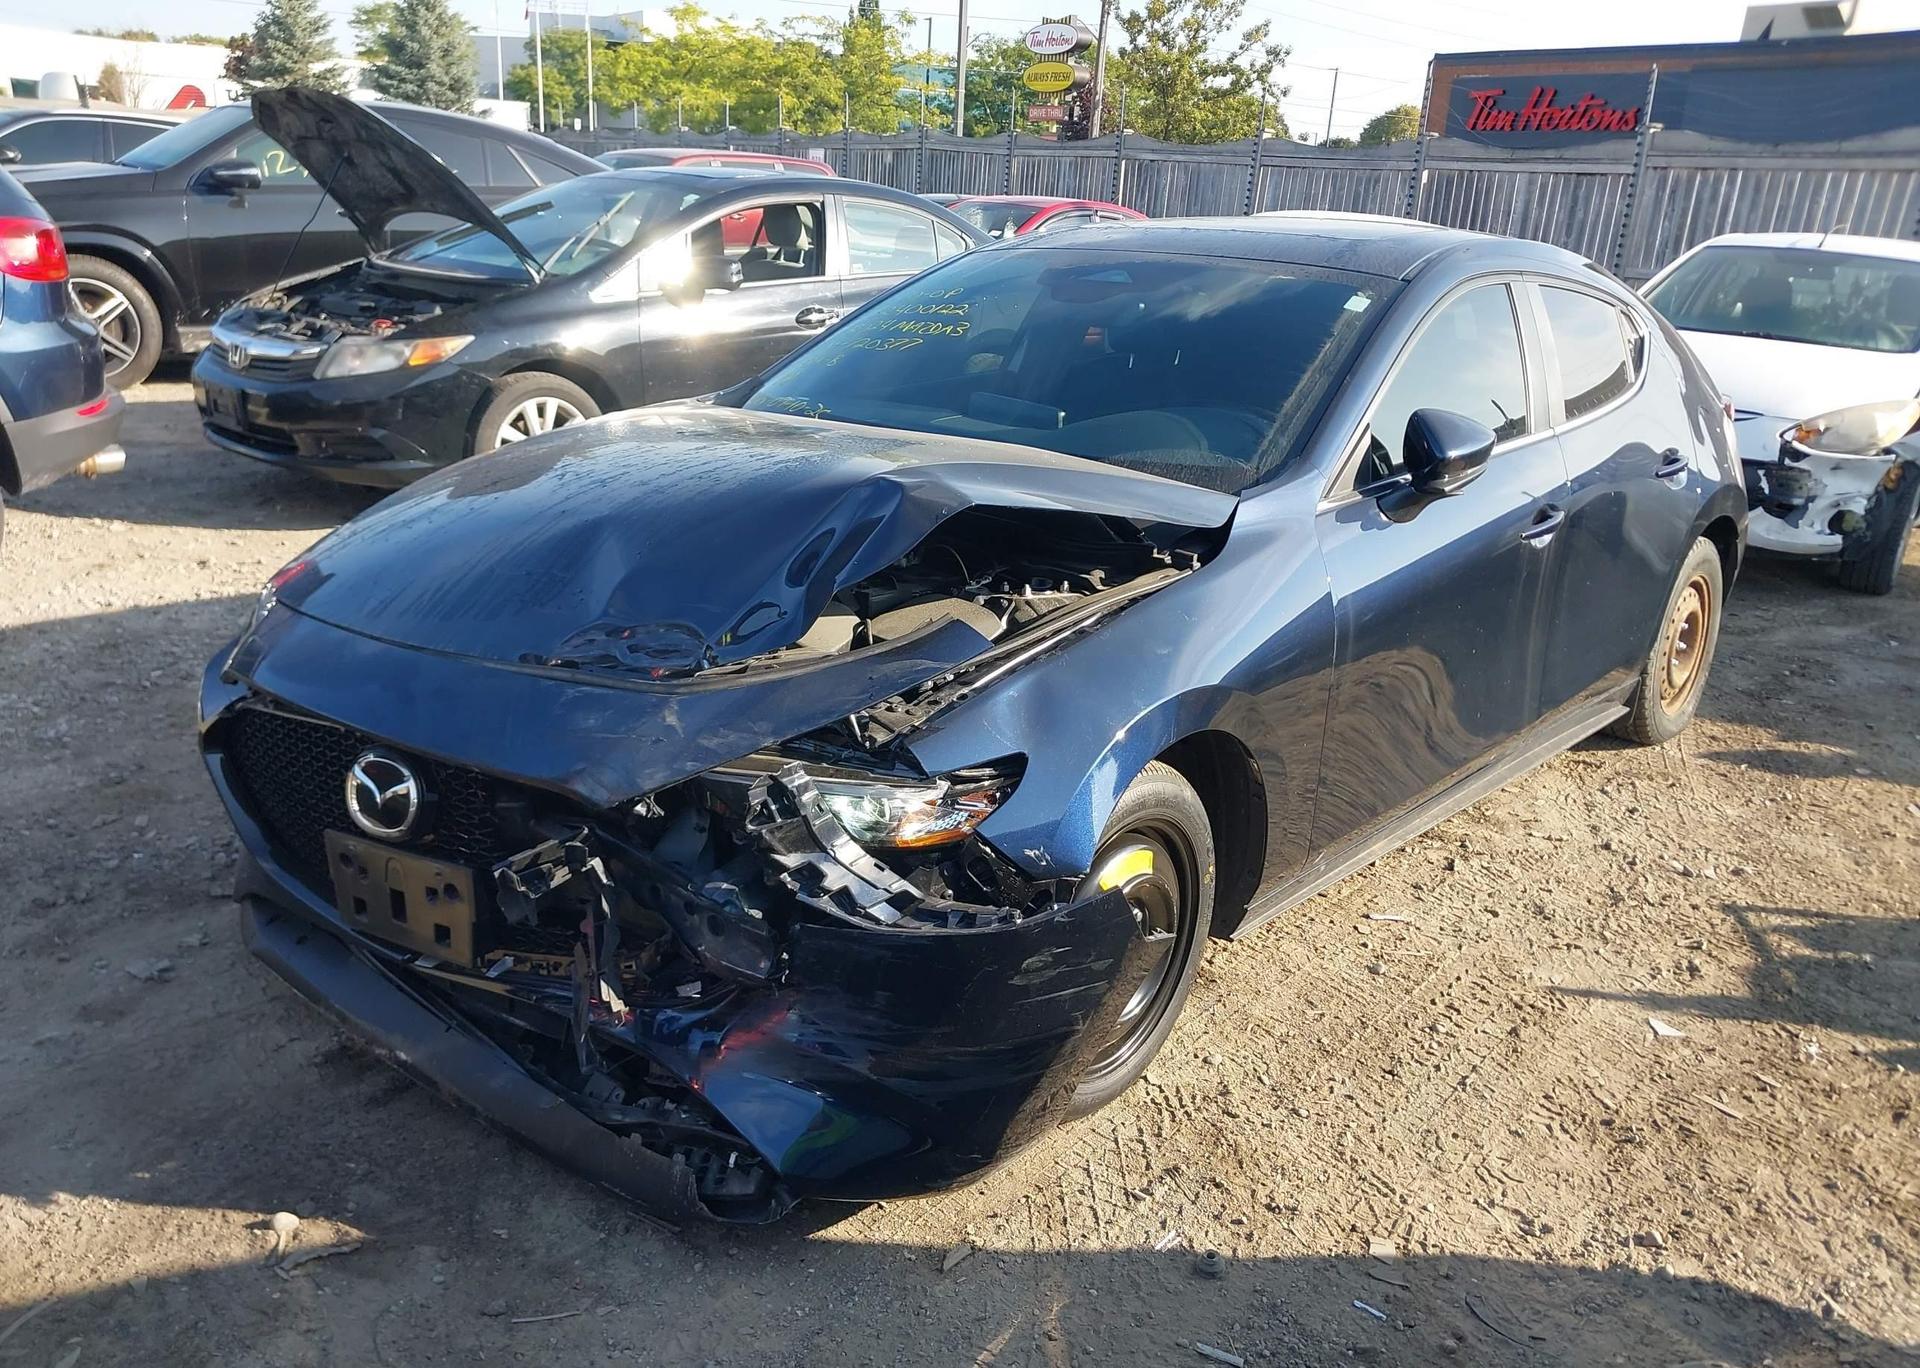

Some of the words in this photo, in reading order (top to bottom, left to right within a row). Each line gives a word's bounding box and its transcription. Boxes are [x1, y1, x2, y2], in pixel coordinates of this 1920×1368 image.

[1030, 32, 1044, 48] Tim
[1044, 30, 1074, 47] Hortons
[1026, 72, 1050, 82] ALWAYS
[1050, 71, 1072, 82] FRESH
[1029, 108, 1047, 117] DRIVE
[1047, 108, 1063, 117] THRU
[1467, 89, 1517, 132] Tim
[1517, 85, 1640, 132] Hortons
